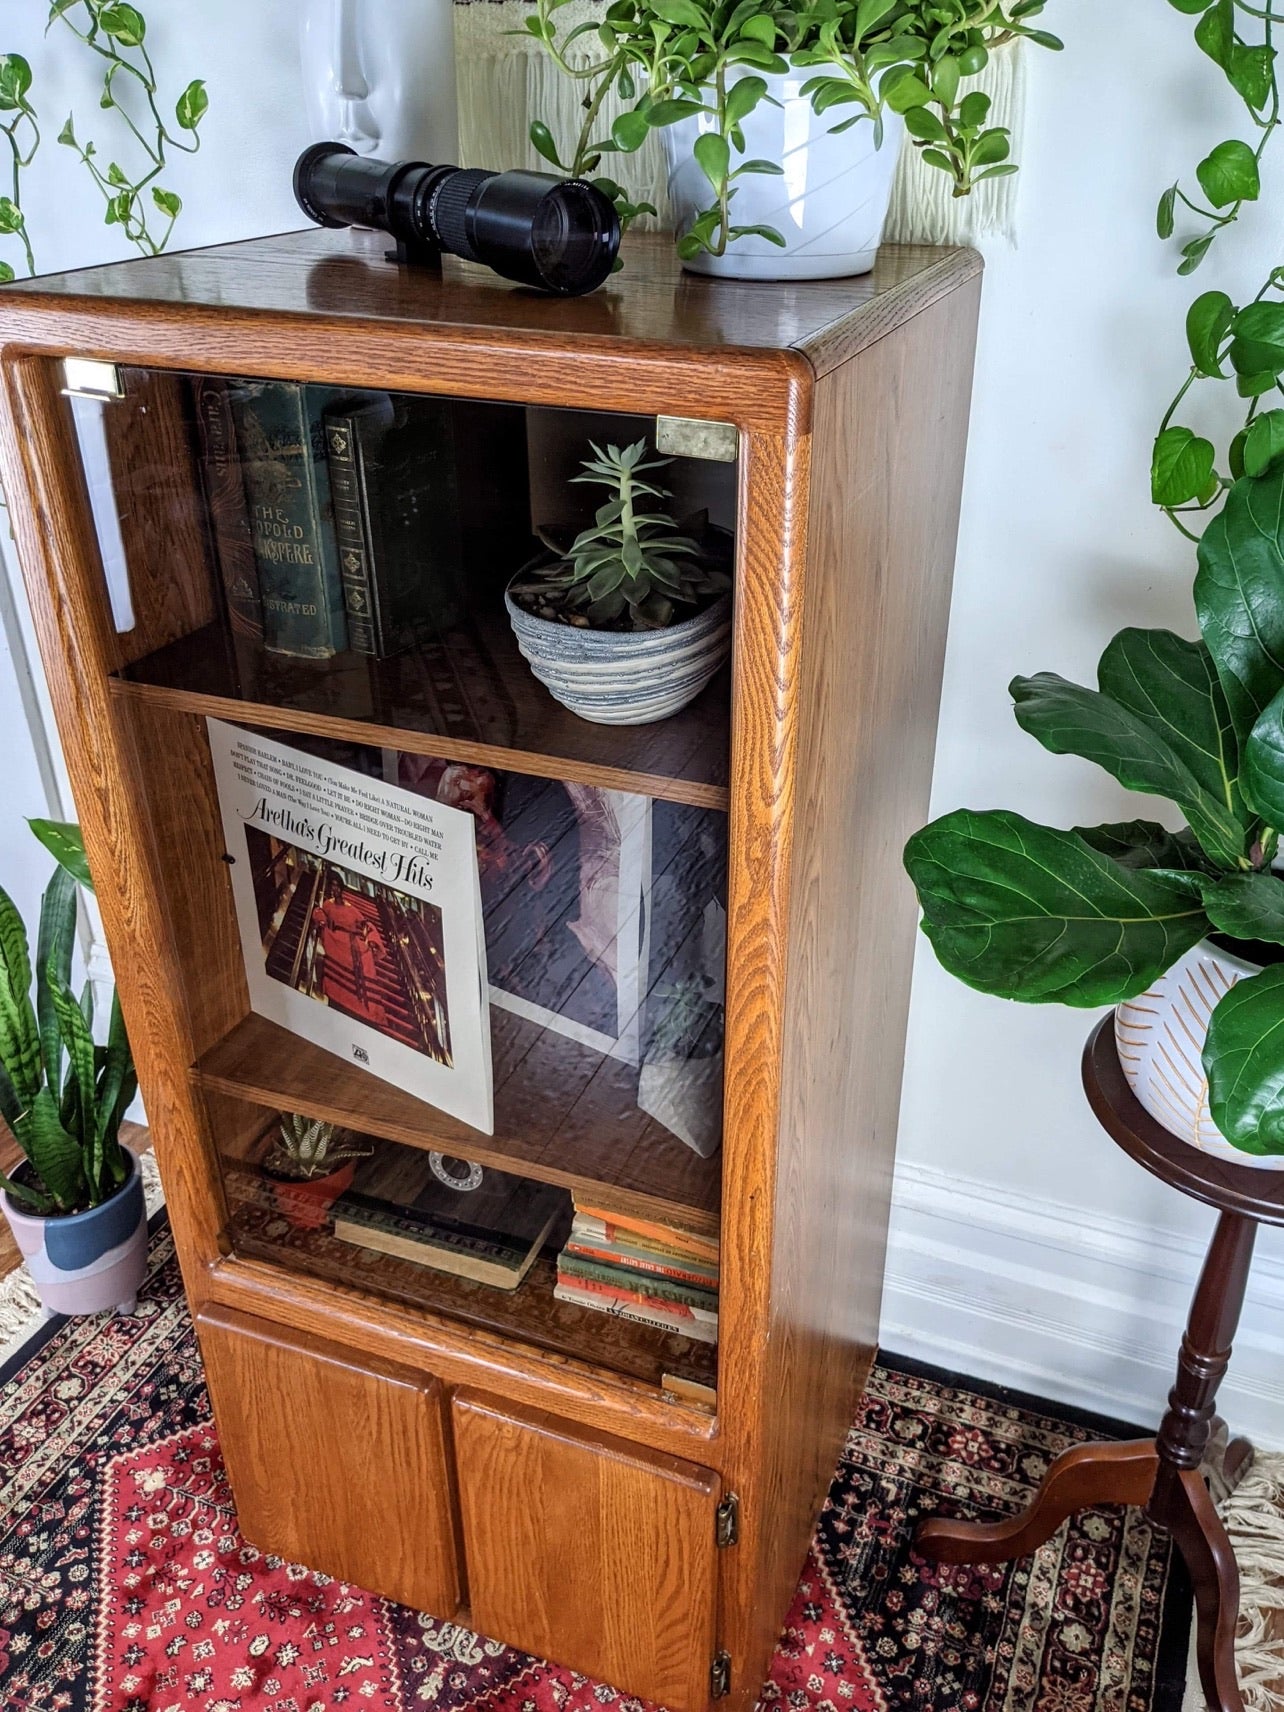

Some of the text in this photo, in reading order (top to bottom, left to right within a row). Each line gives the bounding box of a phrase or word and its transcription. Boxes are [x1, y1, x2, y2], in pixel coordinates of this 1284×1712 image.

[255, 505, 289, 524] THE
[255, 520, 304, 540] OPOLD
[354, 799, 364, 809] DO
[430, 827, 445, 840] MAN
[386, 799, 412, 816] NATURAL
[412, 809, 433, 823] WOMAN
[236, 798, 433, 891] Aretha's Greatest Hits
[366, 825, 382, 839] NEED
[381, 832, 390, 842] TO
[389, 836, 401, 847] GET
[414, 845, 429, 858] CALL
[429, 851, 439, 863] ME
[379, 820, 395, 833] OVER
[394, 826, 424, 844] TROUBLED
[423, 837, 443, 851] WATER
